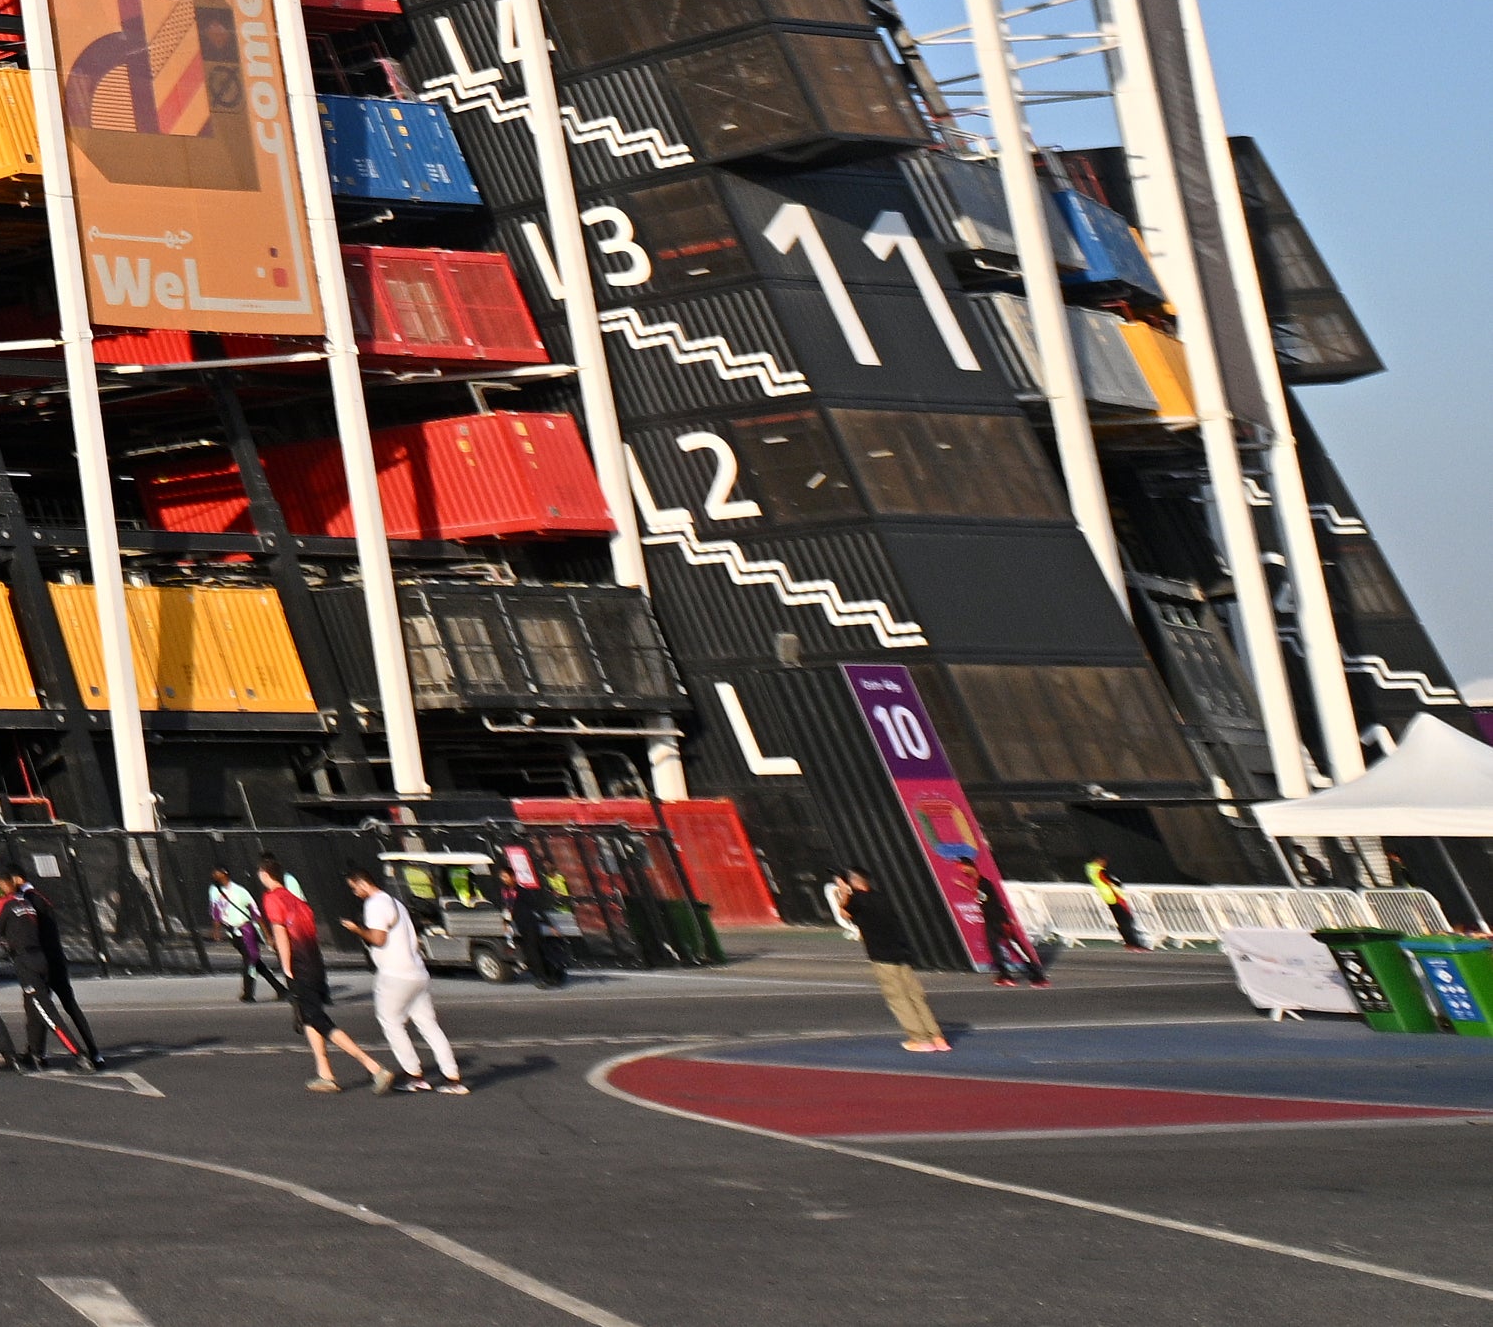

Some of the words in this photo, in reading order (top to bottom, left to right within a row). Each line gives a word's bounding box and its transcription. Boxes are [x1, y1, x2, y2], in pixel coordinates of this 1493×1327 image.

[92, 253, 202, 311] Wel
[762, 203, 983, 373] 11
[623, 432, 763, 527] L2
[872, 704, 931, 760] 10
